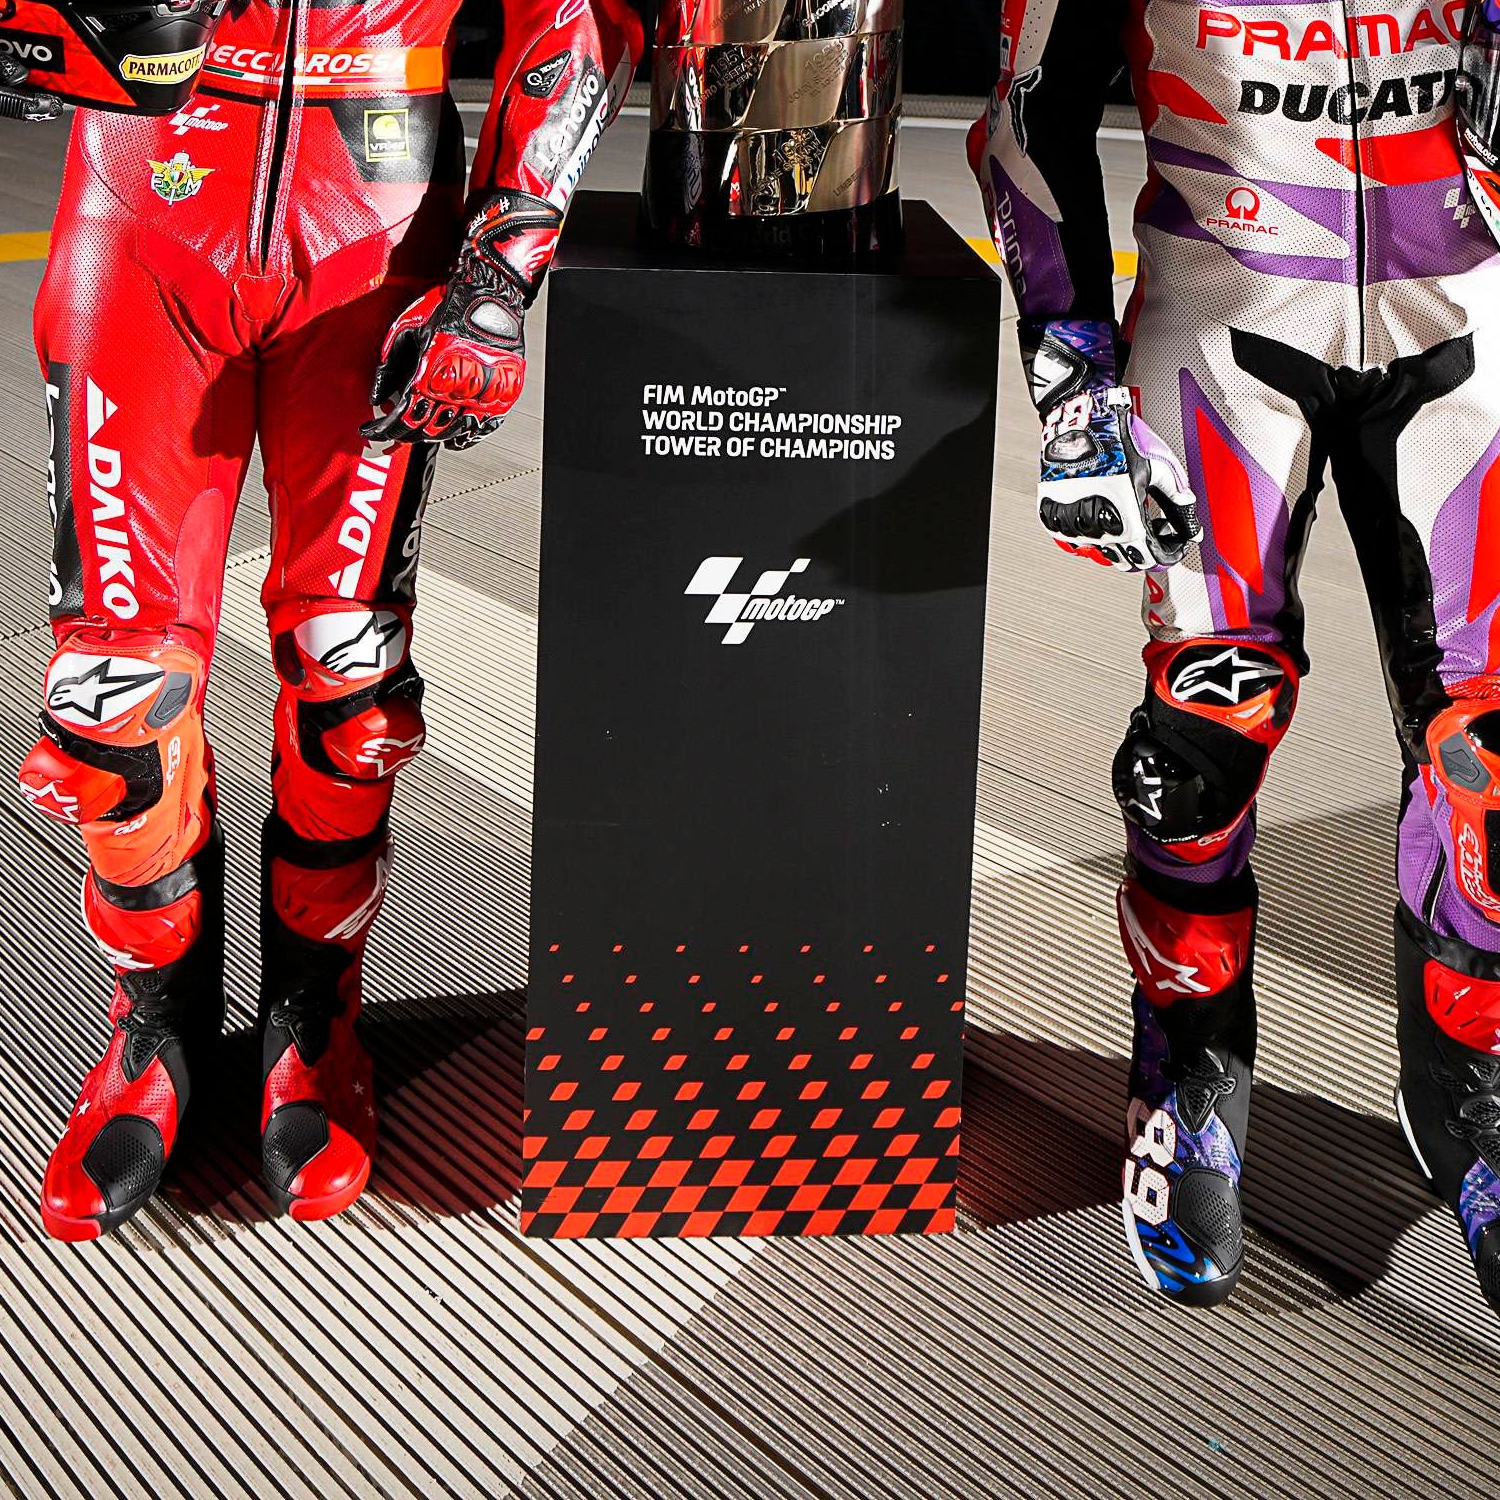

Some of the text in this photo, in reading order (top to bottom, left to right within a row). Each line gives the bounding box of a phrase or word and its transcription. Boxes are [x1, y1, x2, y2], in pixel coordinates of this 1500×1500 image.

[129, 49, 204, 76] PARMACOTT
[204, 43, 406, 75] RECCIAROSSA
[709, 45, 745, 79] 1957
[536, 74, 600, 172] Lenovo
[1206, 217, 1279, 236] PRAMAC
[998, 191, 1027, 300] prima
[643, 385, 685, 406] FIM
[642, 410, 902, 435] WORLD CHAMPIONSHIP
[641, 435, 896, 461] TOWER OF CHAMPIONS
